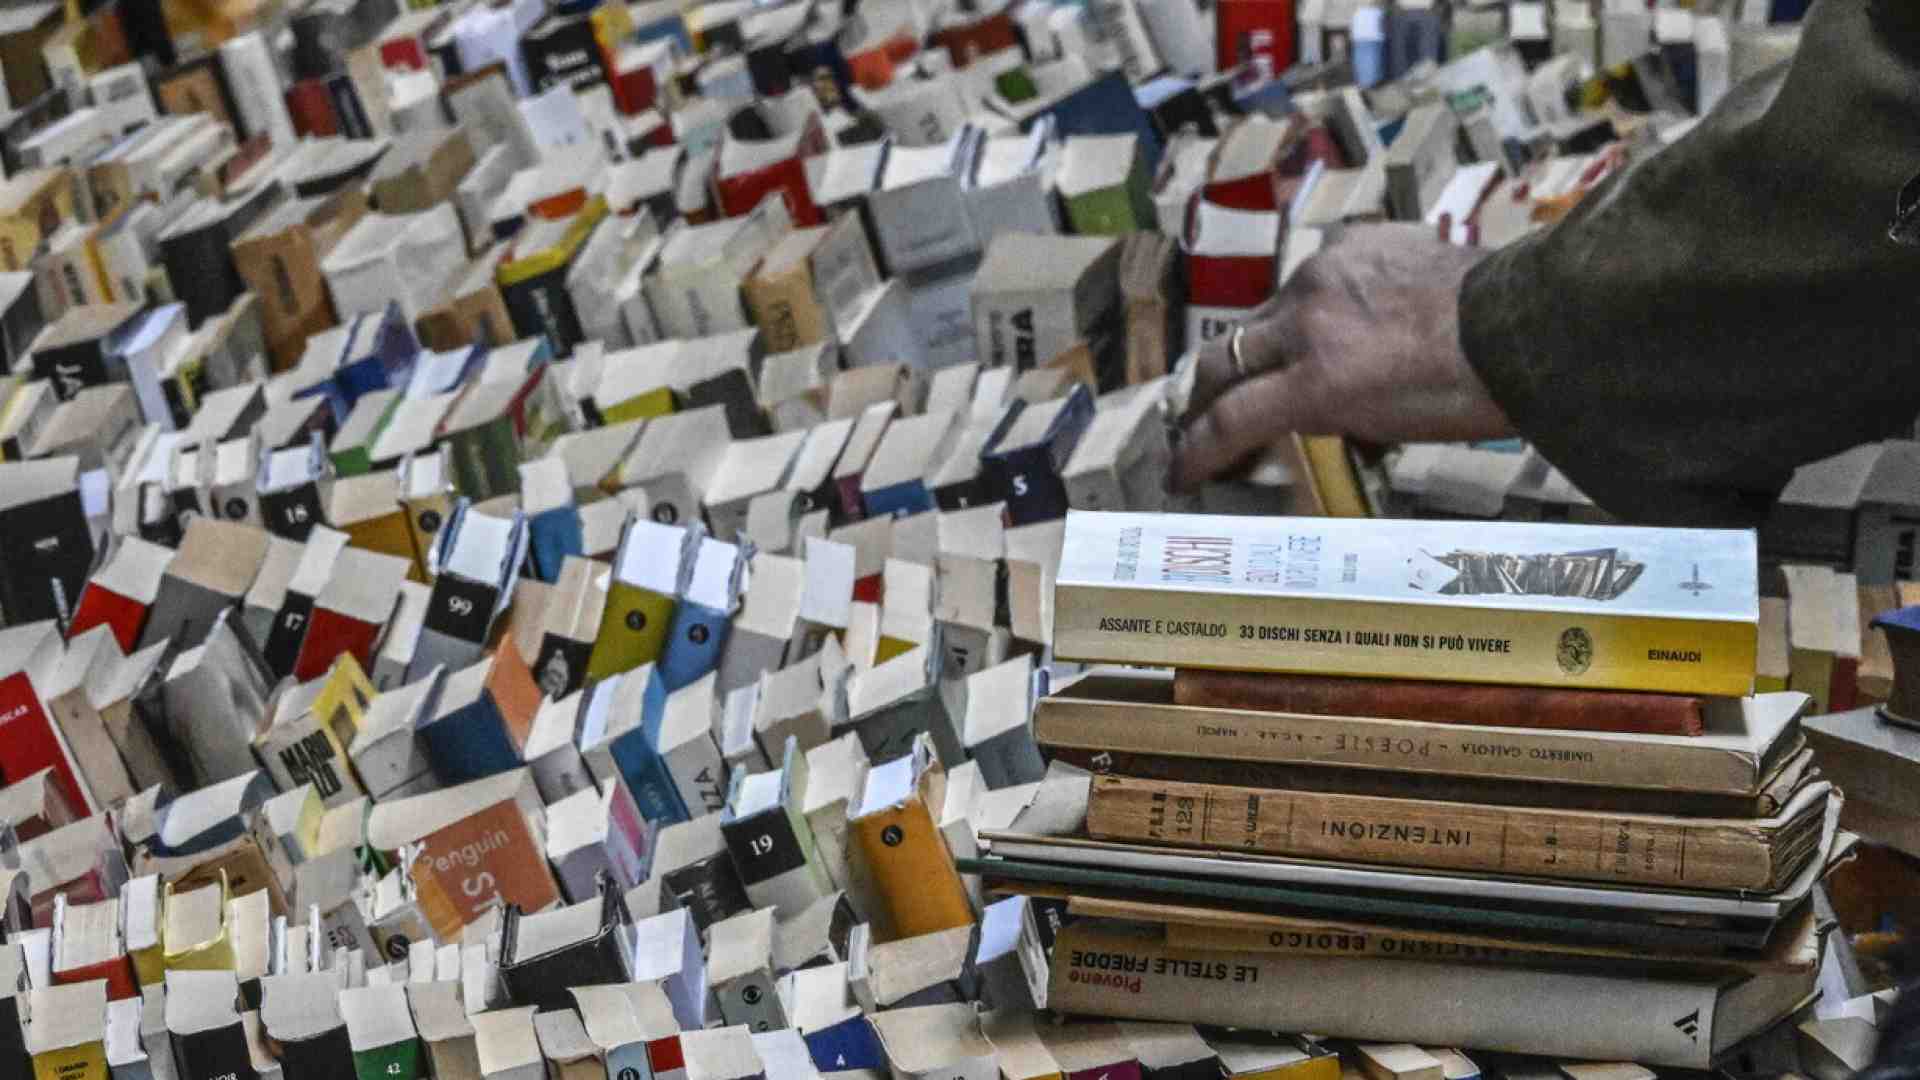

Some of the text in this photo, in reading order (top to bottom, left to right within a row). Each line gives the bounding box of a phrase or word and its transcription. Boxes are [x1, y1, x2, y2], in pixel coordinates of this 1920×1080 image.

[447, 595, 473, 617] 99
[1099, 617, 1512, 653] ASSANTE E CASTALDO 33 DISCHI SENZA I QUALI NON SI PUÒ VIVERE
[1647, 649, 1702, 664] EINAUDI
[1334, 733, 1431, 757] POESIE
[1529, 747, 1593, 762] UMBERTO
[750, 833, 774, 856] 19
[1320, 820, 1471, 846] INTENZIONI
[420, 830, 510, 881] Penguin
[1269, 931, 1366, 951] EROICO
[1071, 950, 1260, 983] LE STELLE FREDDE
[1068, 969, 1142, 994] Piovene
